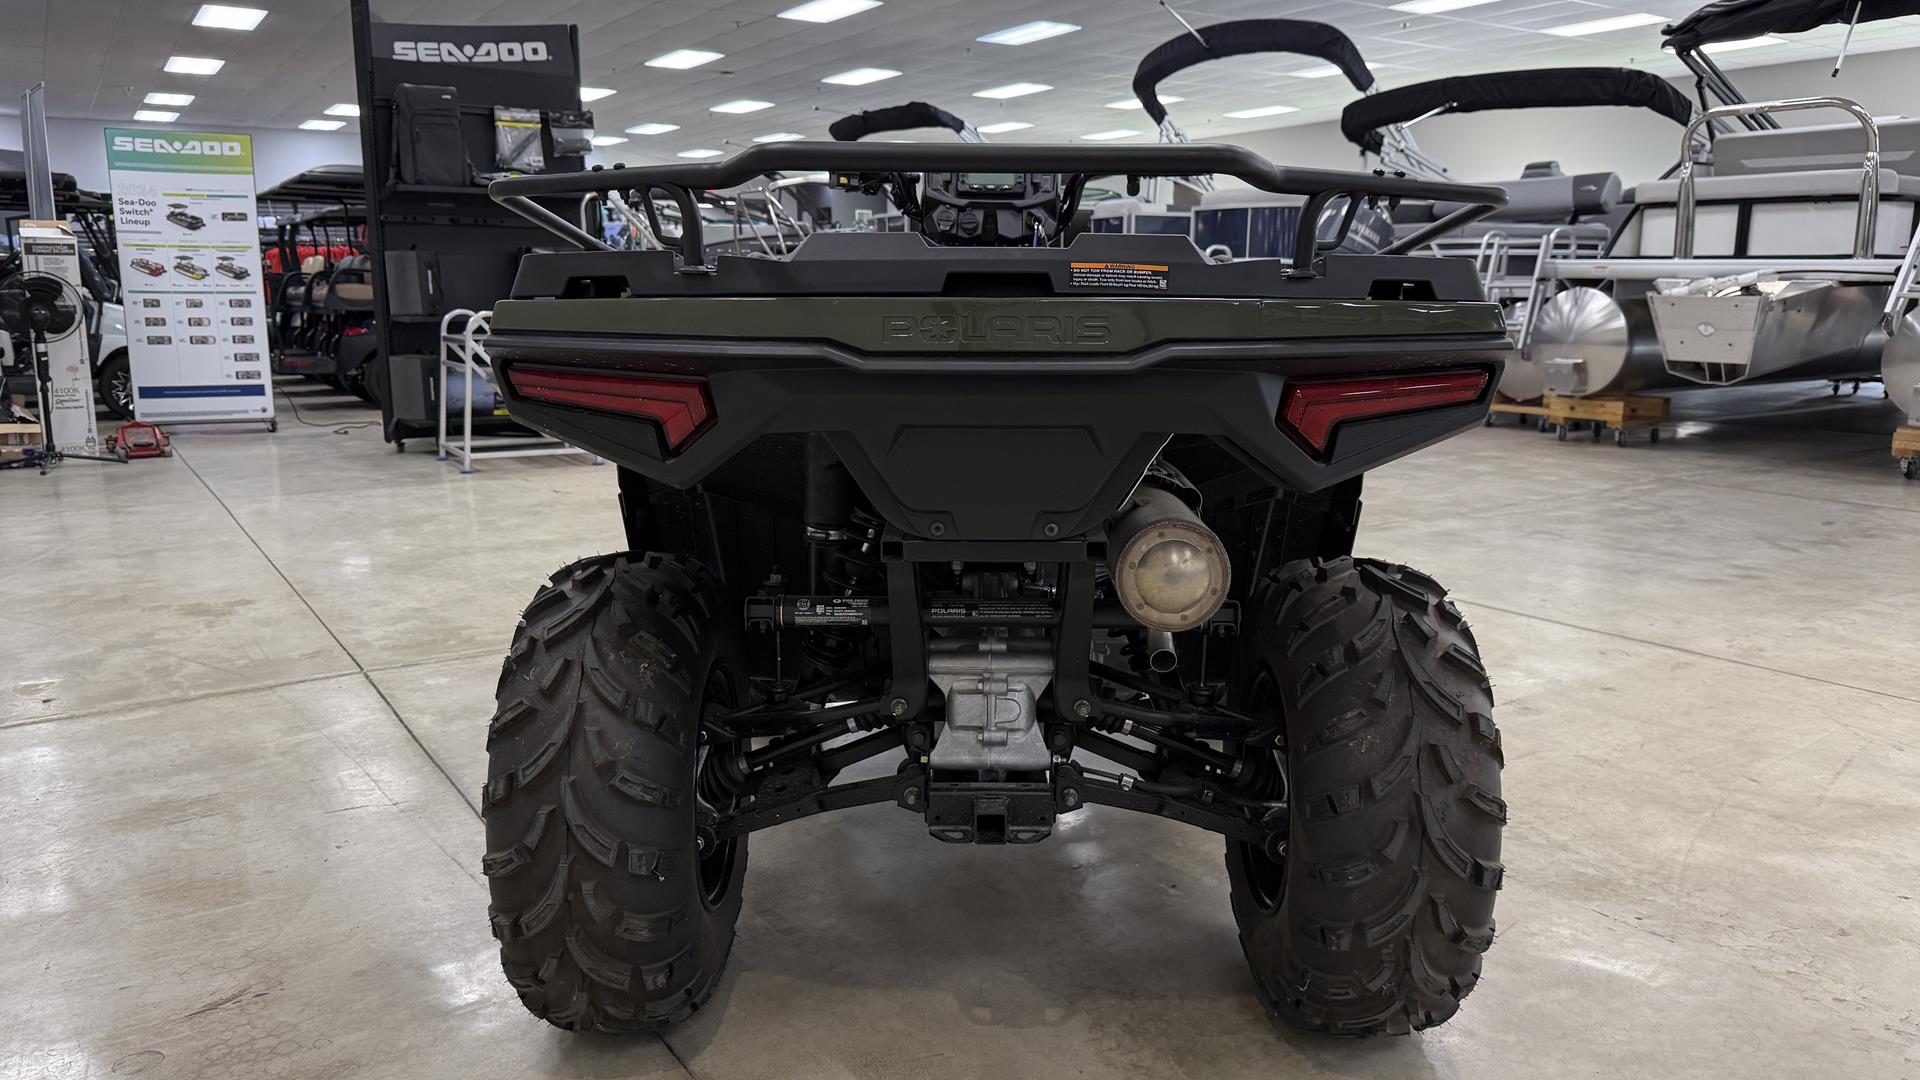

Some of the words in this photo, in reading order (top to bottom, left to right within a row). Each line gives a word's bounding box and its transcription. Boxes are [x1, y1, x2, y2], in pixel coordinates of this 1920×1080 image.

[118, 198, 157, 207] Sea-Doo
[120, 217, 151, 227] Lineup
[882, 316, 1111, 344] POLARIS
